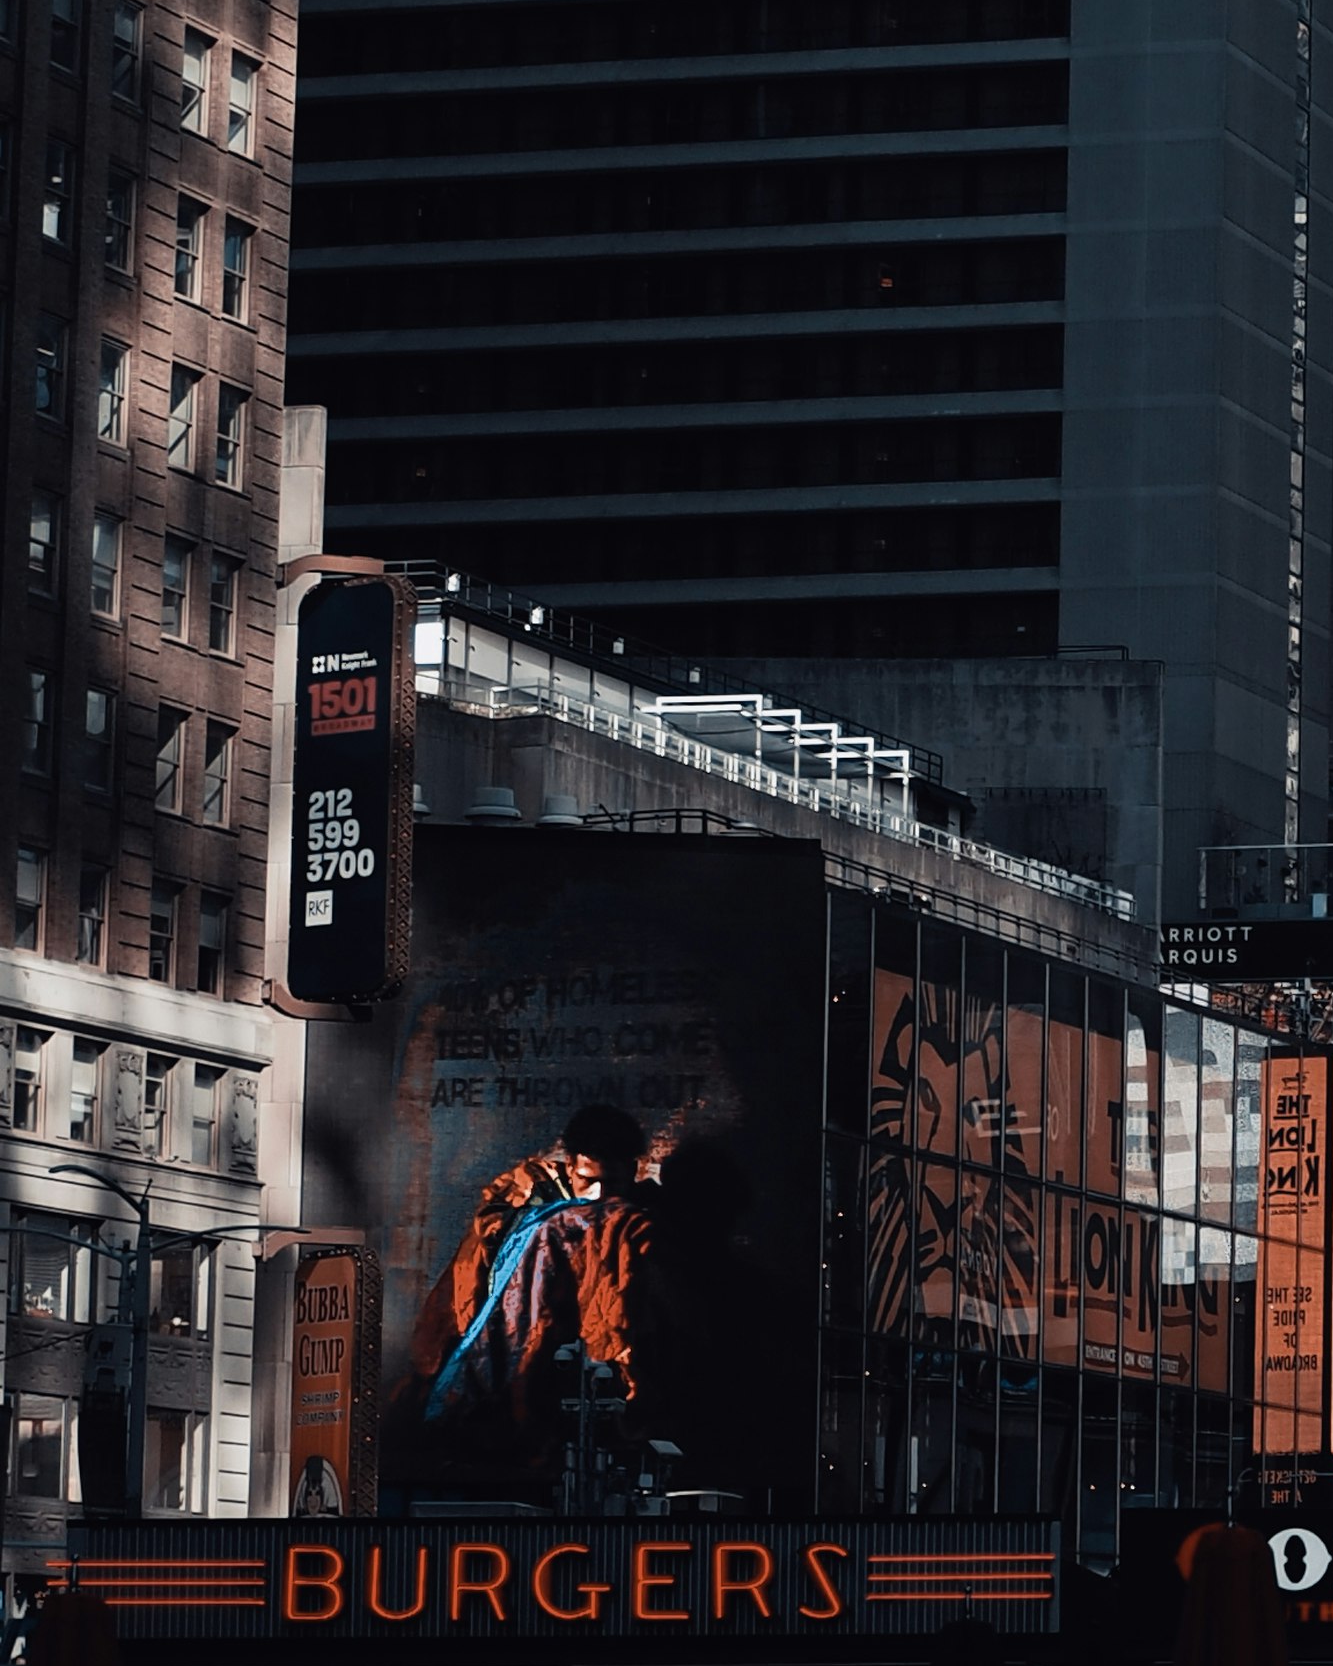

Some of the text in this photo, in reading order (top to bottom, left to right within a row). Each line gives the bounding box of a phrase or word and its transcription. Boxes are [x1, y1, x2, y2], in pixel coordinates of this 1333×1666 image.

[308, 676, 376, 719] 1501
[309, 789, 352, 819] 212
[308, 819, 359, 850] 599
[307, 849, 374, 882] 3700
[308, 899, 330, 916] RKF
[436, 1018, 713, 1061] TEENS WHO COME
[431, 1073, 706, 1110] ARE THROWN OUT
[297, 1282, 349, 1324] BUBBA
[299, 1335, 344, 1377] GUMP
[302, 1391, 340, 1406] SHRIMP
[297, 1410, 344, 1426] COMPANY
[283, 1540, 848, 1623] BURGERS
